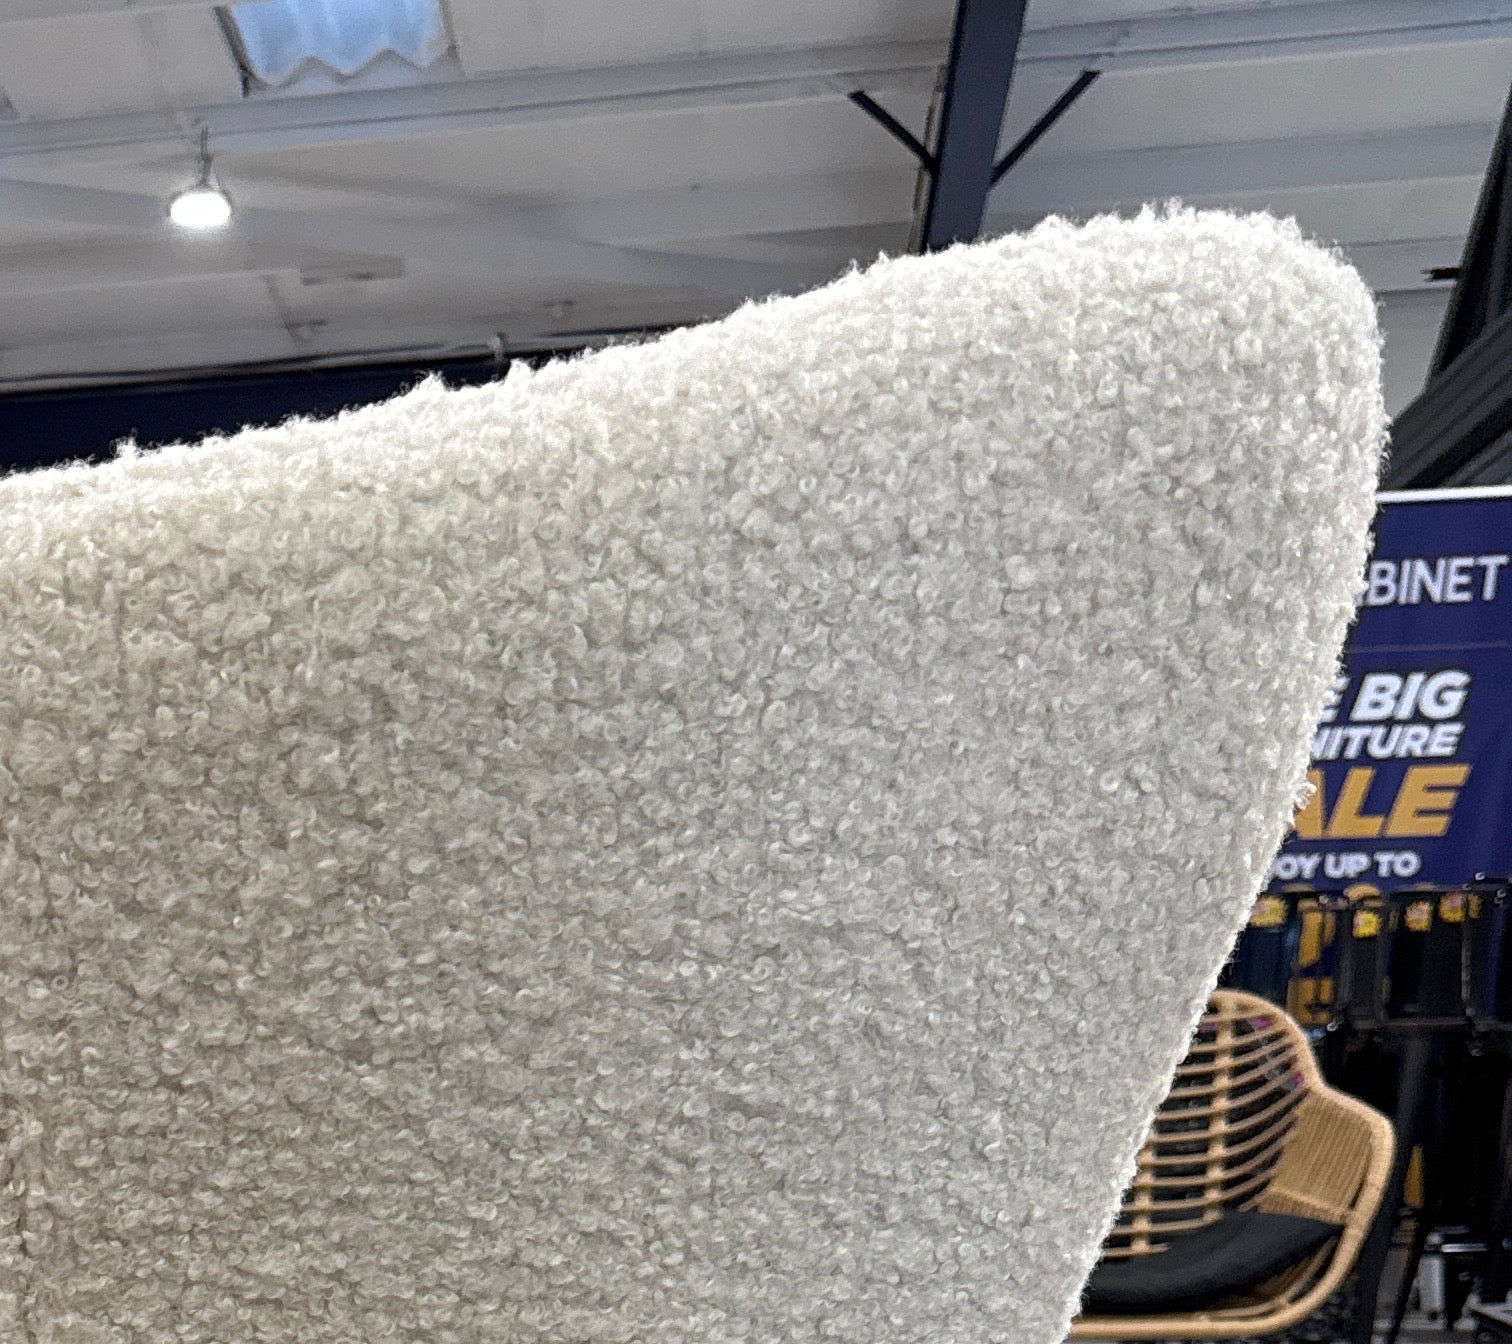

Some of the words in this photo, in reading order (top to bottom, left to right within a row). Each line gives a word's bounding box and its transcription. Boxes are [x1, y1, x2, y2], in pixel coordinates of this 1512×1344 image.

[1367, 555, 1510, 606] BINET
[1350, 669, 1472, 720] BIG
[1273, 851, 1323, 880] OY
[1324, 851, 1372, 879] UP
[1373, 850, 1422, 878] TO
